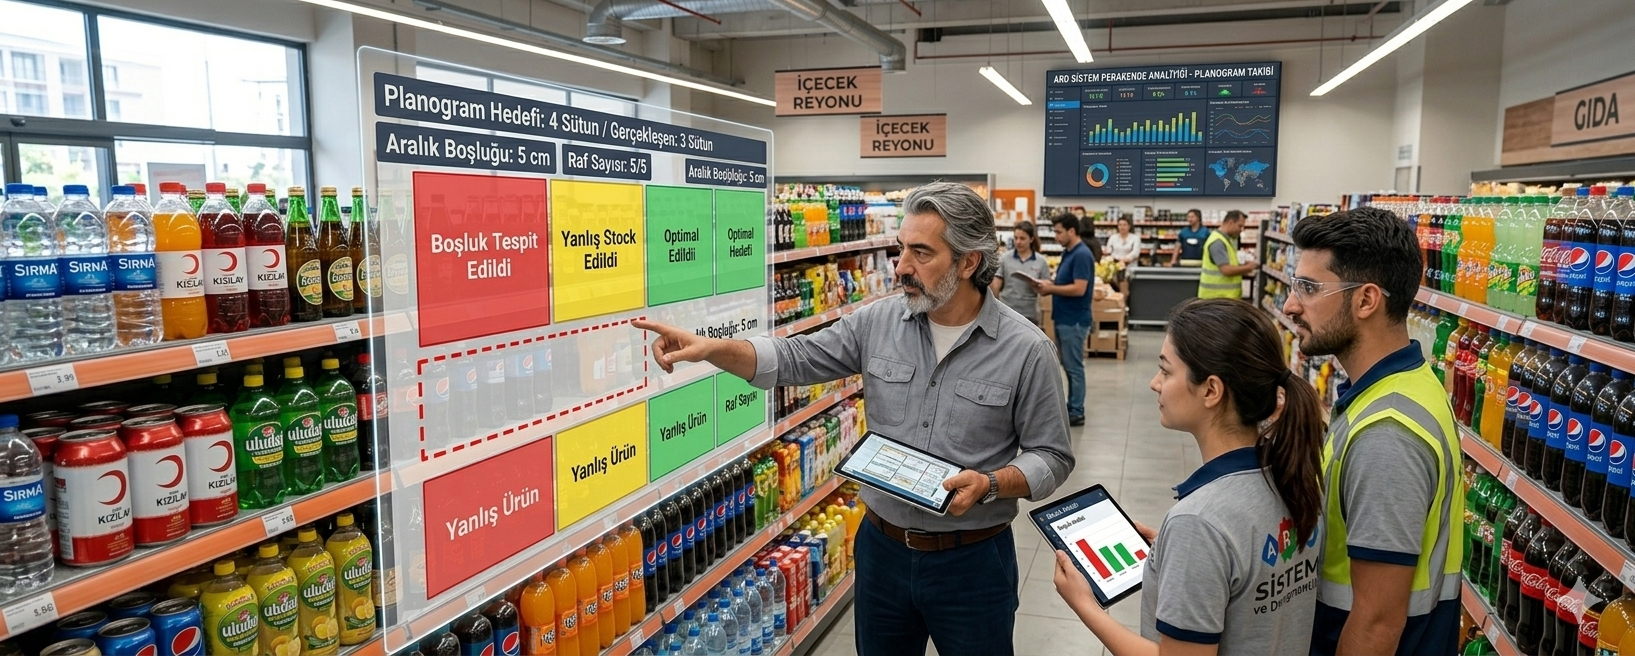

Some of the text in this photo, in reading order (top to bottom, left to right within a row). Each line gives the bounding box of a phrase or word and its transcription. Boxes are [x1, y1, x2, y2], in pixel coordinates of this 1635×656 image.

[1194, 68, 1246, 78] PLANOGRAM
[797, 75, 858, 94] İÇECEK
[793, 95, 862, 110] REYONU
[1574, 92, 1619, 131] GIDA
[384, 83, 713, 152] Planogram Hedefi: 4 Sütun / Gerçekleşen: 3 Sütun
[875, 119, 930, 137] İÇECEK
[385, 133, 551, 167] Aralık Boşluğu: 5 cm
[872, 139, 934, 151] REYONU
[568, 151, 588, 169] Raf
[630, 157, 647, 174] 5/5
[749, 170, 754, 183] 5
[431, 231, 539, 258] Boşluk Tespit
[561, 228, 637, 250] Yanlış Stock
[664, 227, 699, 246] Optimal
[14, 262, 58, 277] SIRMA
[467, 257, 512, 280] Edildi
[584, 251, 618, 270] Edildi
[741, 318, 746, 331] 5
[725, 394, 738, 413] Raf
[571, 443, 636, 483] Yanlış Ürün
[3, 484, 43, 502] SIRMA
[445, 486, 540, 541] Yanlış Ürün
[1253, 605, 1268, 615] ve
